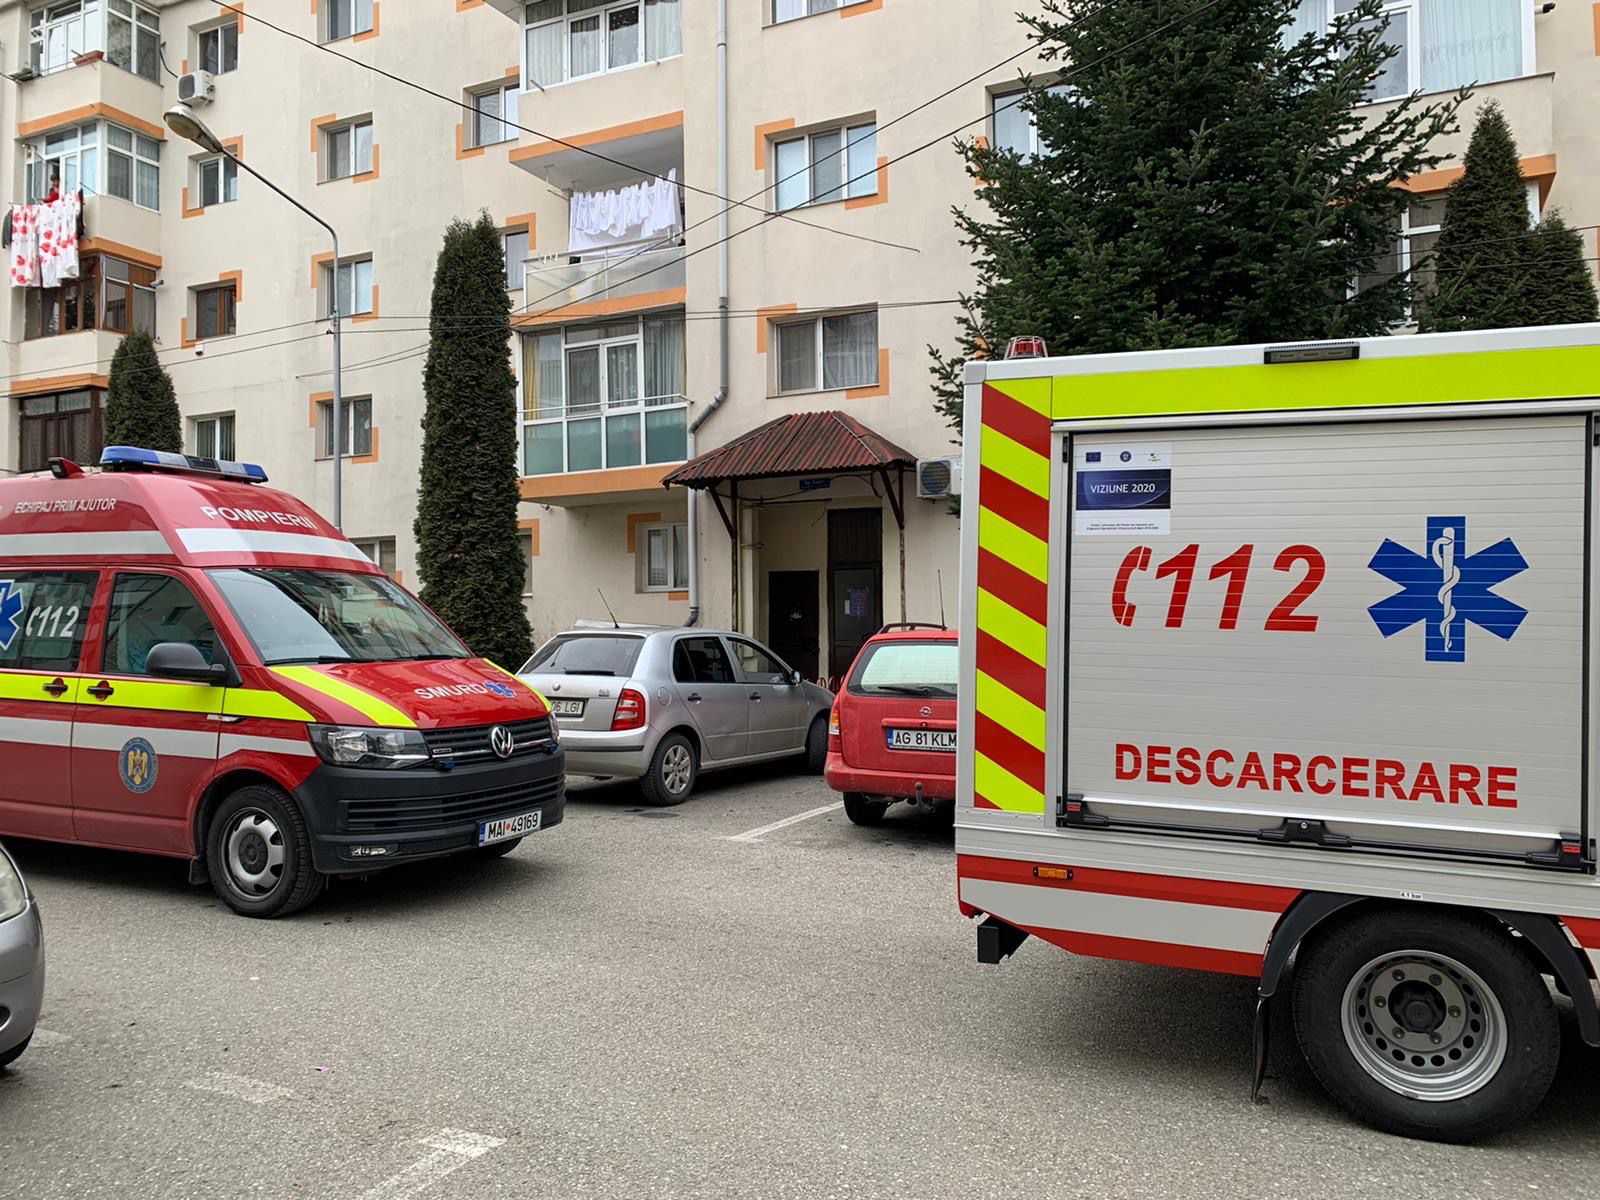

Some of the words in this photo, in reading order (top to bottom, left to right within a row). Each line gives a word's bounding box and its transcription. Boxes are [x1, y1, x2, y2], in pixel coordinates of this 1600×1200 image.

[1090, 483, 1129, 494] VIZIUNE
[1131, 483, 1156, 493] 2020
[14, 501, 53, 514] ECHIPAJ
[52, 500, 78, 512] PRIM
[76, 498, 117, 511] AJUTOR
[200, 506, 319, 530] POMPIERII
[1155, 543, 1326, 632] 112
[37, 605, 80, 638] 112
[414, 683, 489, 700] SMURD
[564, 702, 581, 713] LGI
[895, 731, 911, 745] AG
[915, 732, 928, 745] 81
[931, 733, 957, 747] KLM
[1115, 743, 1519, 809] DESCARCERARE
[488, 821, 506, 839] MAI
[511, 813, 539, 833] 49169
